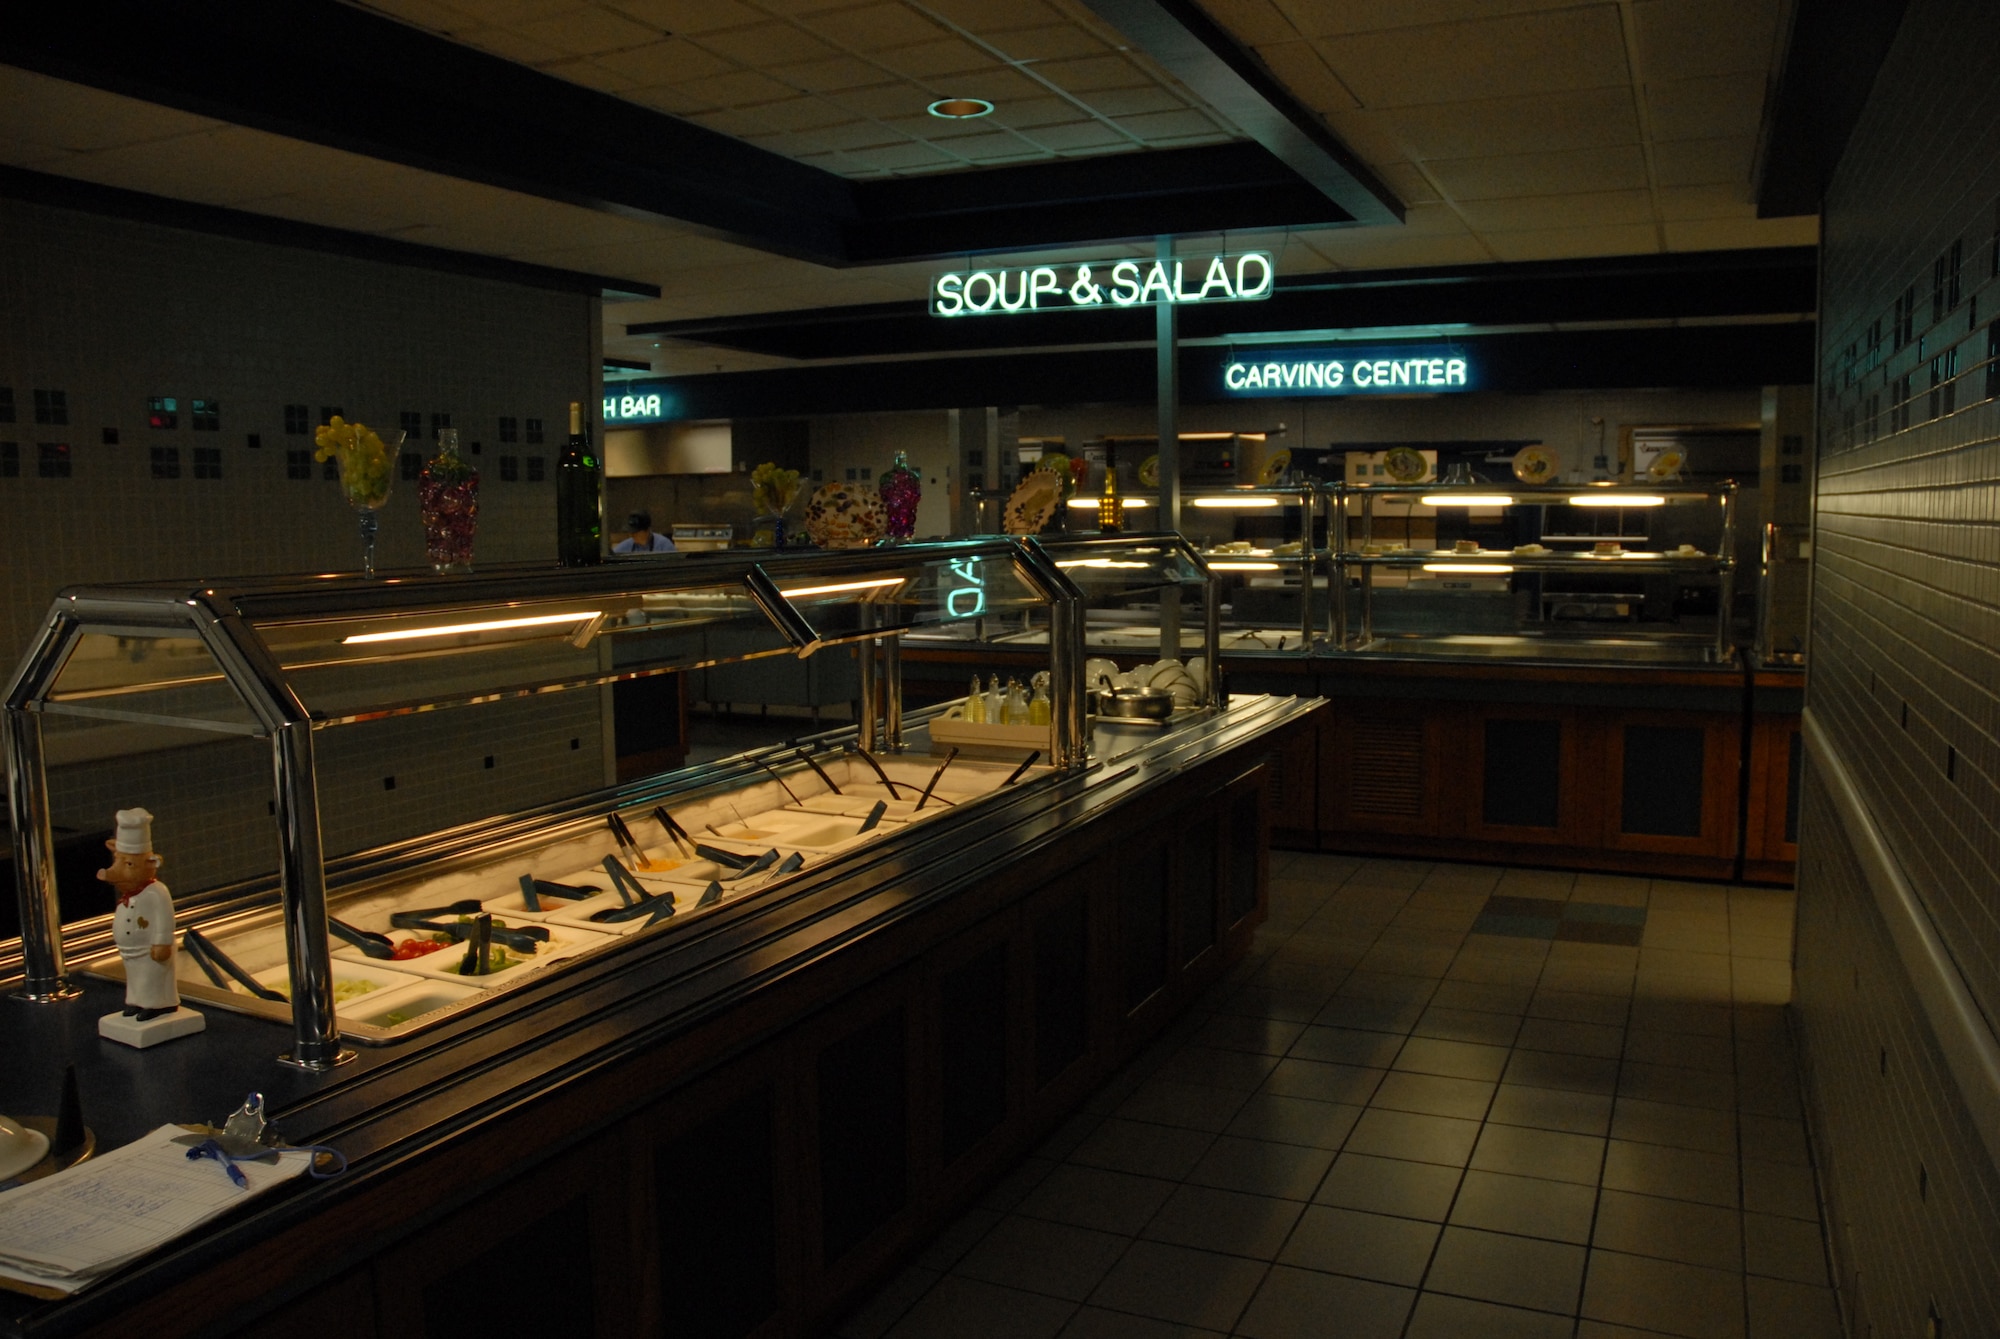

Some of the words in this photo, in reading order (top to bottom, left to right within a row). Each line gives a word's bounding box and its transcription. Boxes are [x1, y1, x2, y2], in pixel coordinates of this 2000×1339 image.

[936, 267, 1062, 315] SOUP
[1069, 265, 1102, 305] &
[1111, 254, 1271, 305] SALAD
[1225, 361, 1344, 389] CARVING
[1352, 359, 1466, 387] CENTER
[621, 395, 661, 418] BAR
